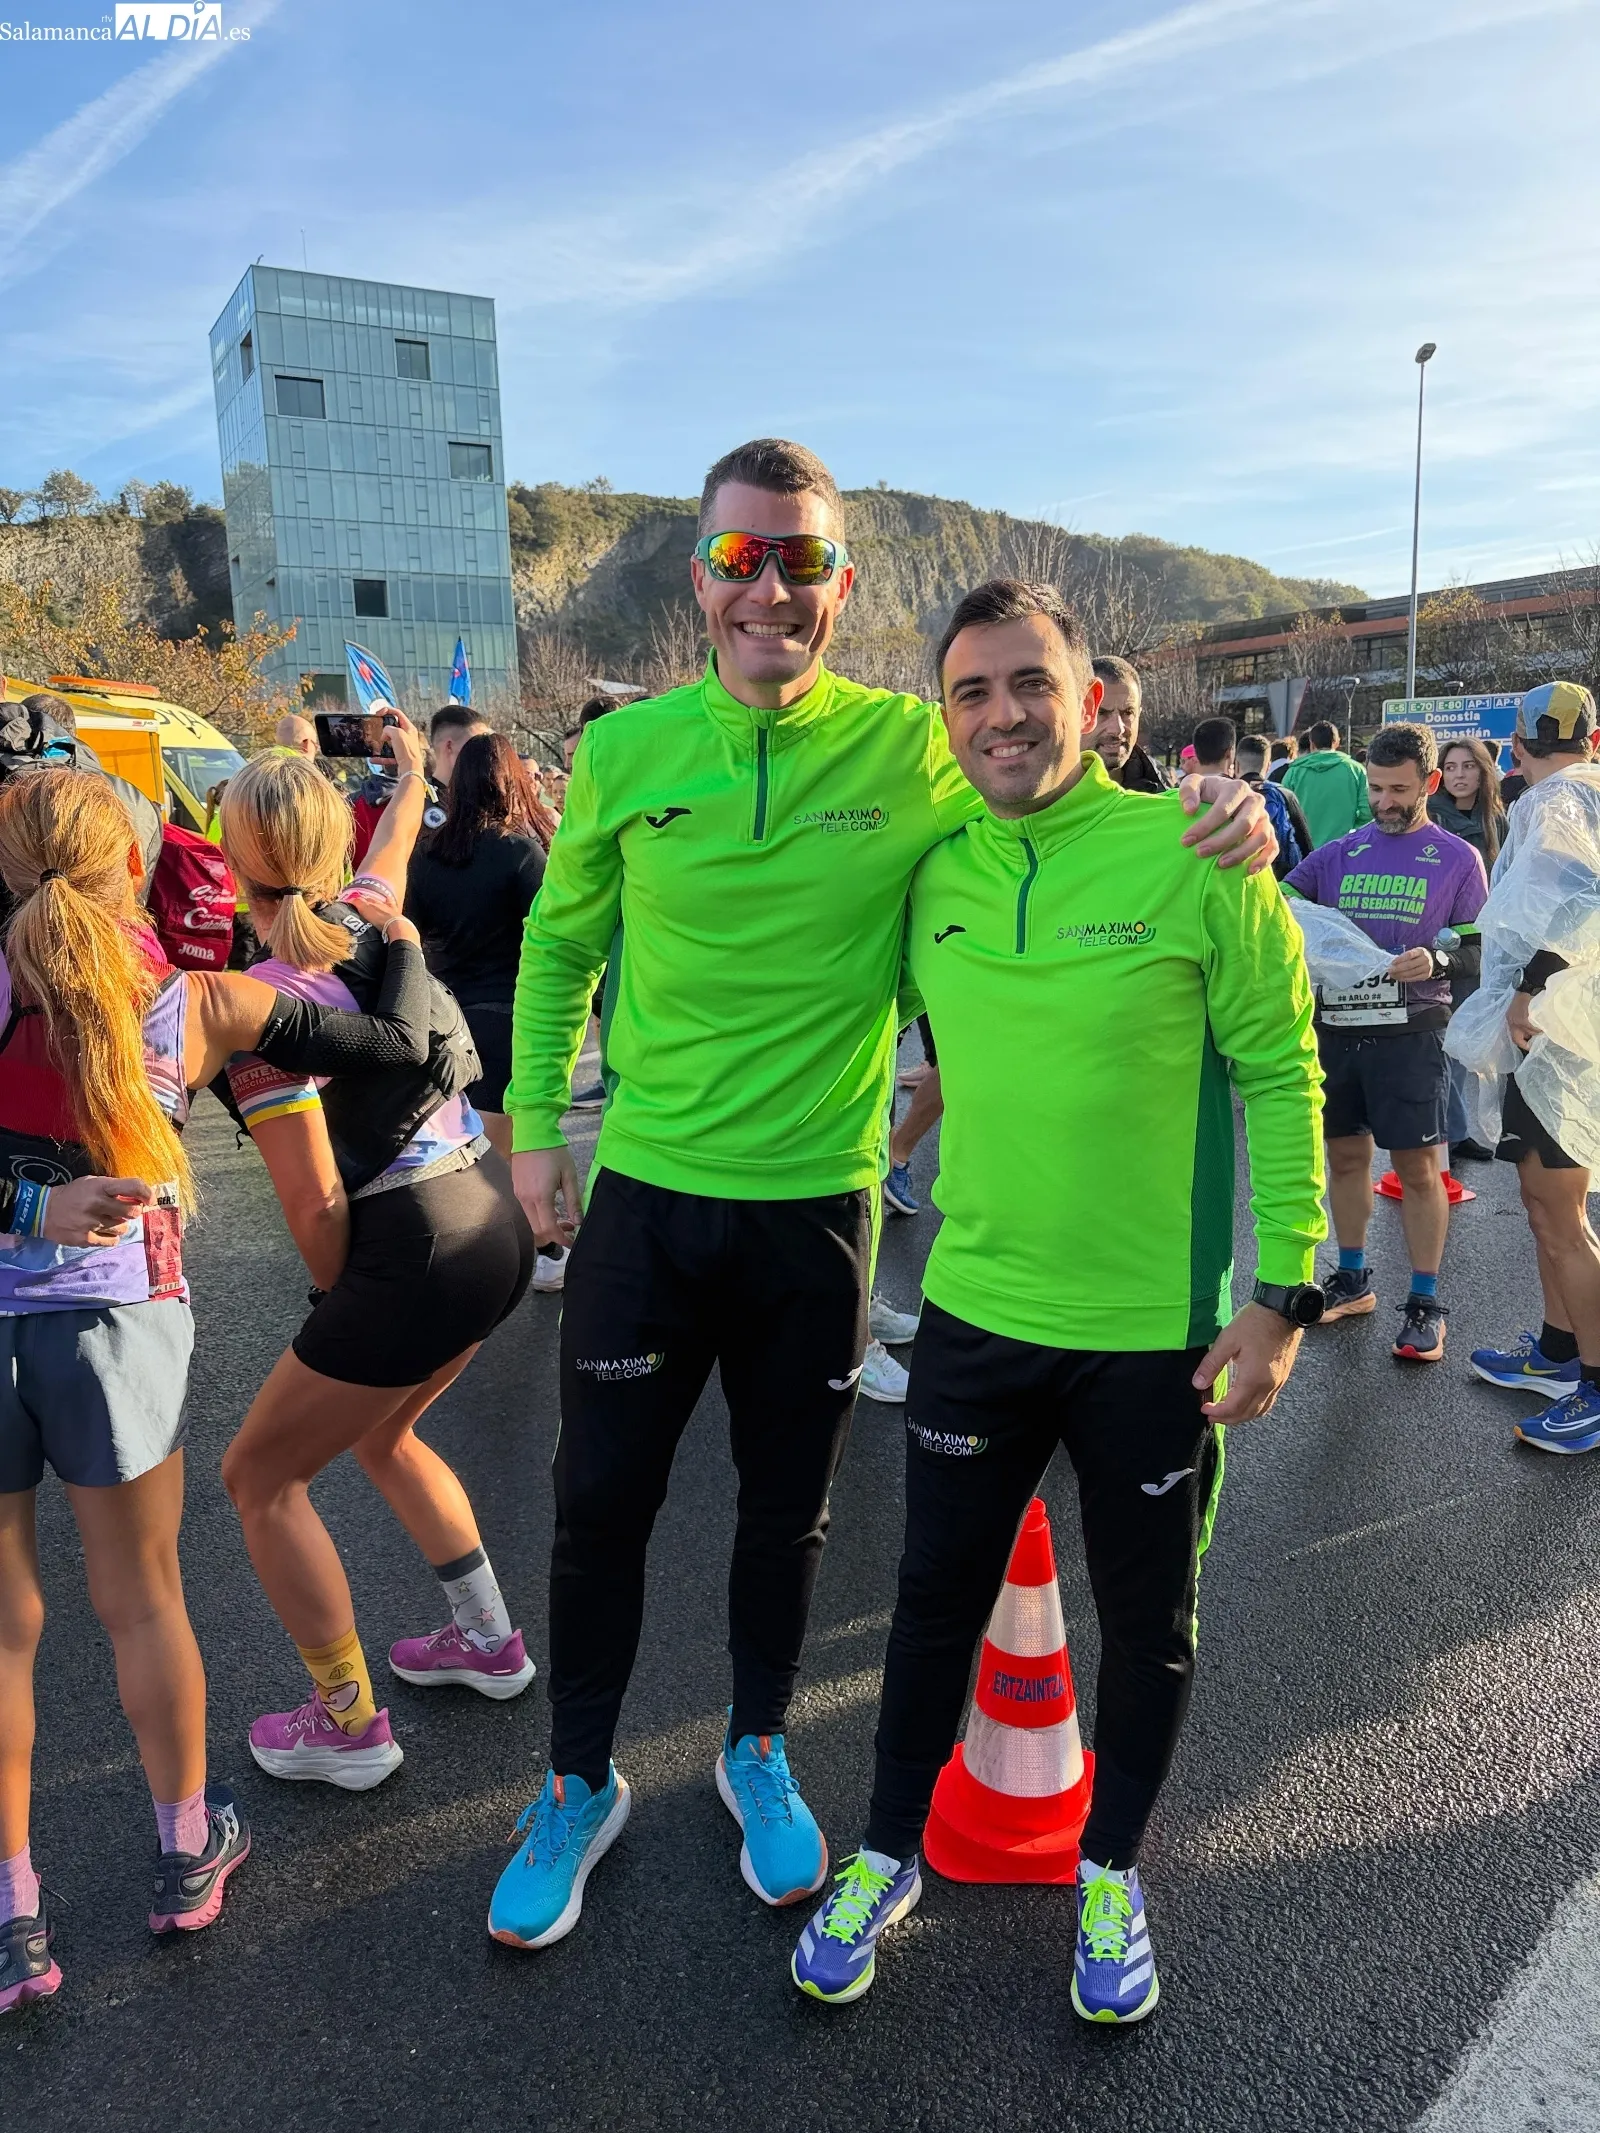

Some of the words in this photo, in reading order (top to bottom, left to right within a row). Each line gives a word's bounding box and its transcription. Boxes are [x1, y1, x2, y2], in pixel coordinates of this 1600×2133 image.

[1388, 702, 1405, 713] E-5
[1410, 701, 1433, 712] E-70
[1437, 699, 1462, 710] E-80
[1467, 697, 1490, 709] AP-1
[1424, 711, 1481, 723] Donostia
[1432, 727, 1491, 740] ebastián
[794, 807, 882, 825] SANMAXIMO
[819, 821, 878, 834] TELECOM
[1340, 873, 1428, 900] BEHOBIA
[1338, 896, 1360, 909] SAN
[1360, 897, 1426, 915] SEBASTIÁN
[1056, 921, 1146, 940] SANMAXIMO
[1077, 934, 1138, 948] TELECOM
[576, 1352, 657, 1371] SANMAXIMO
[594, 1364, 652, 1382] TELECOM
[907, 1416, 979, 1447] SANMAXIMO
[918, 1436, 973, 1456] TELECOM
[992, 1669, 1065, 1702] ERTZAINTZA
